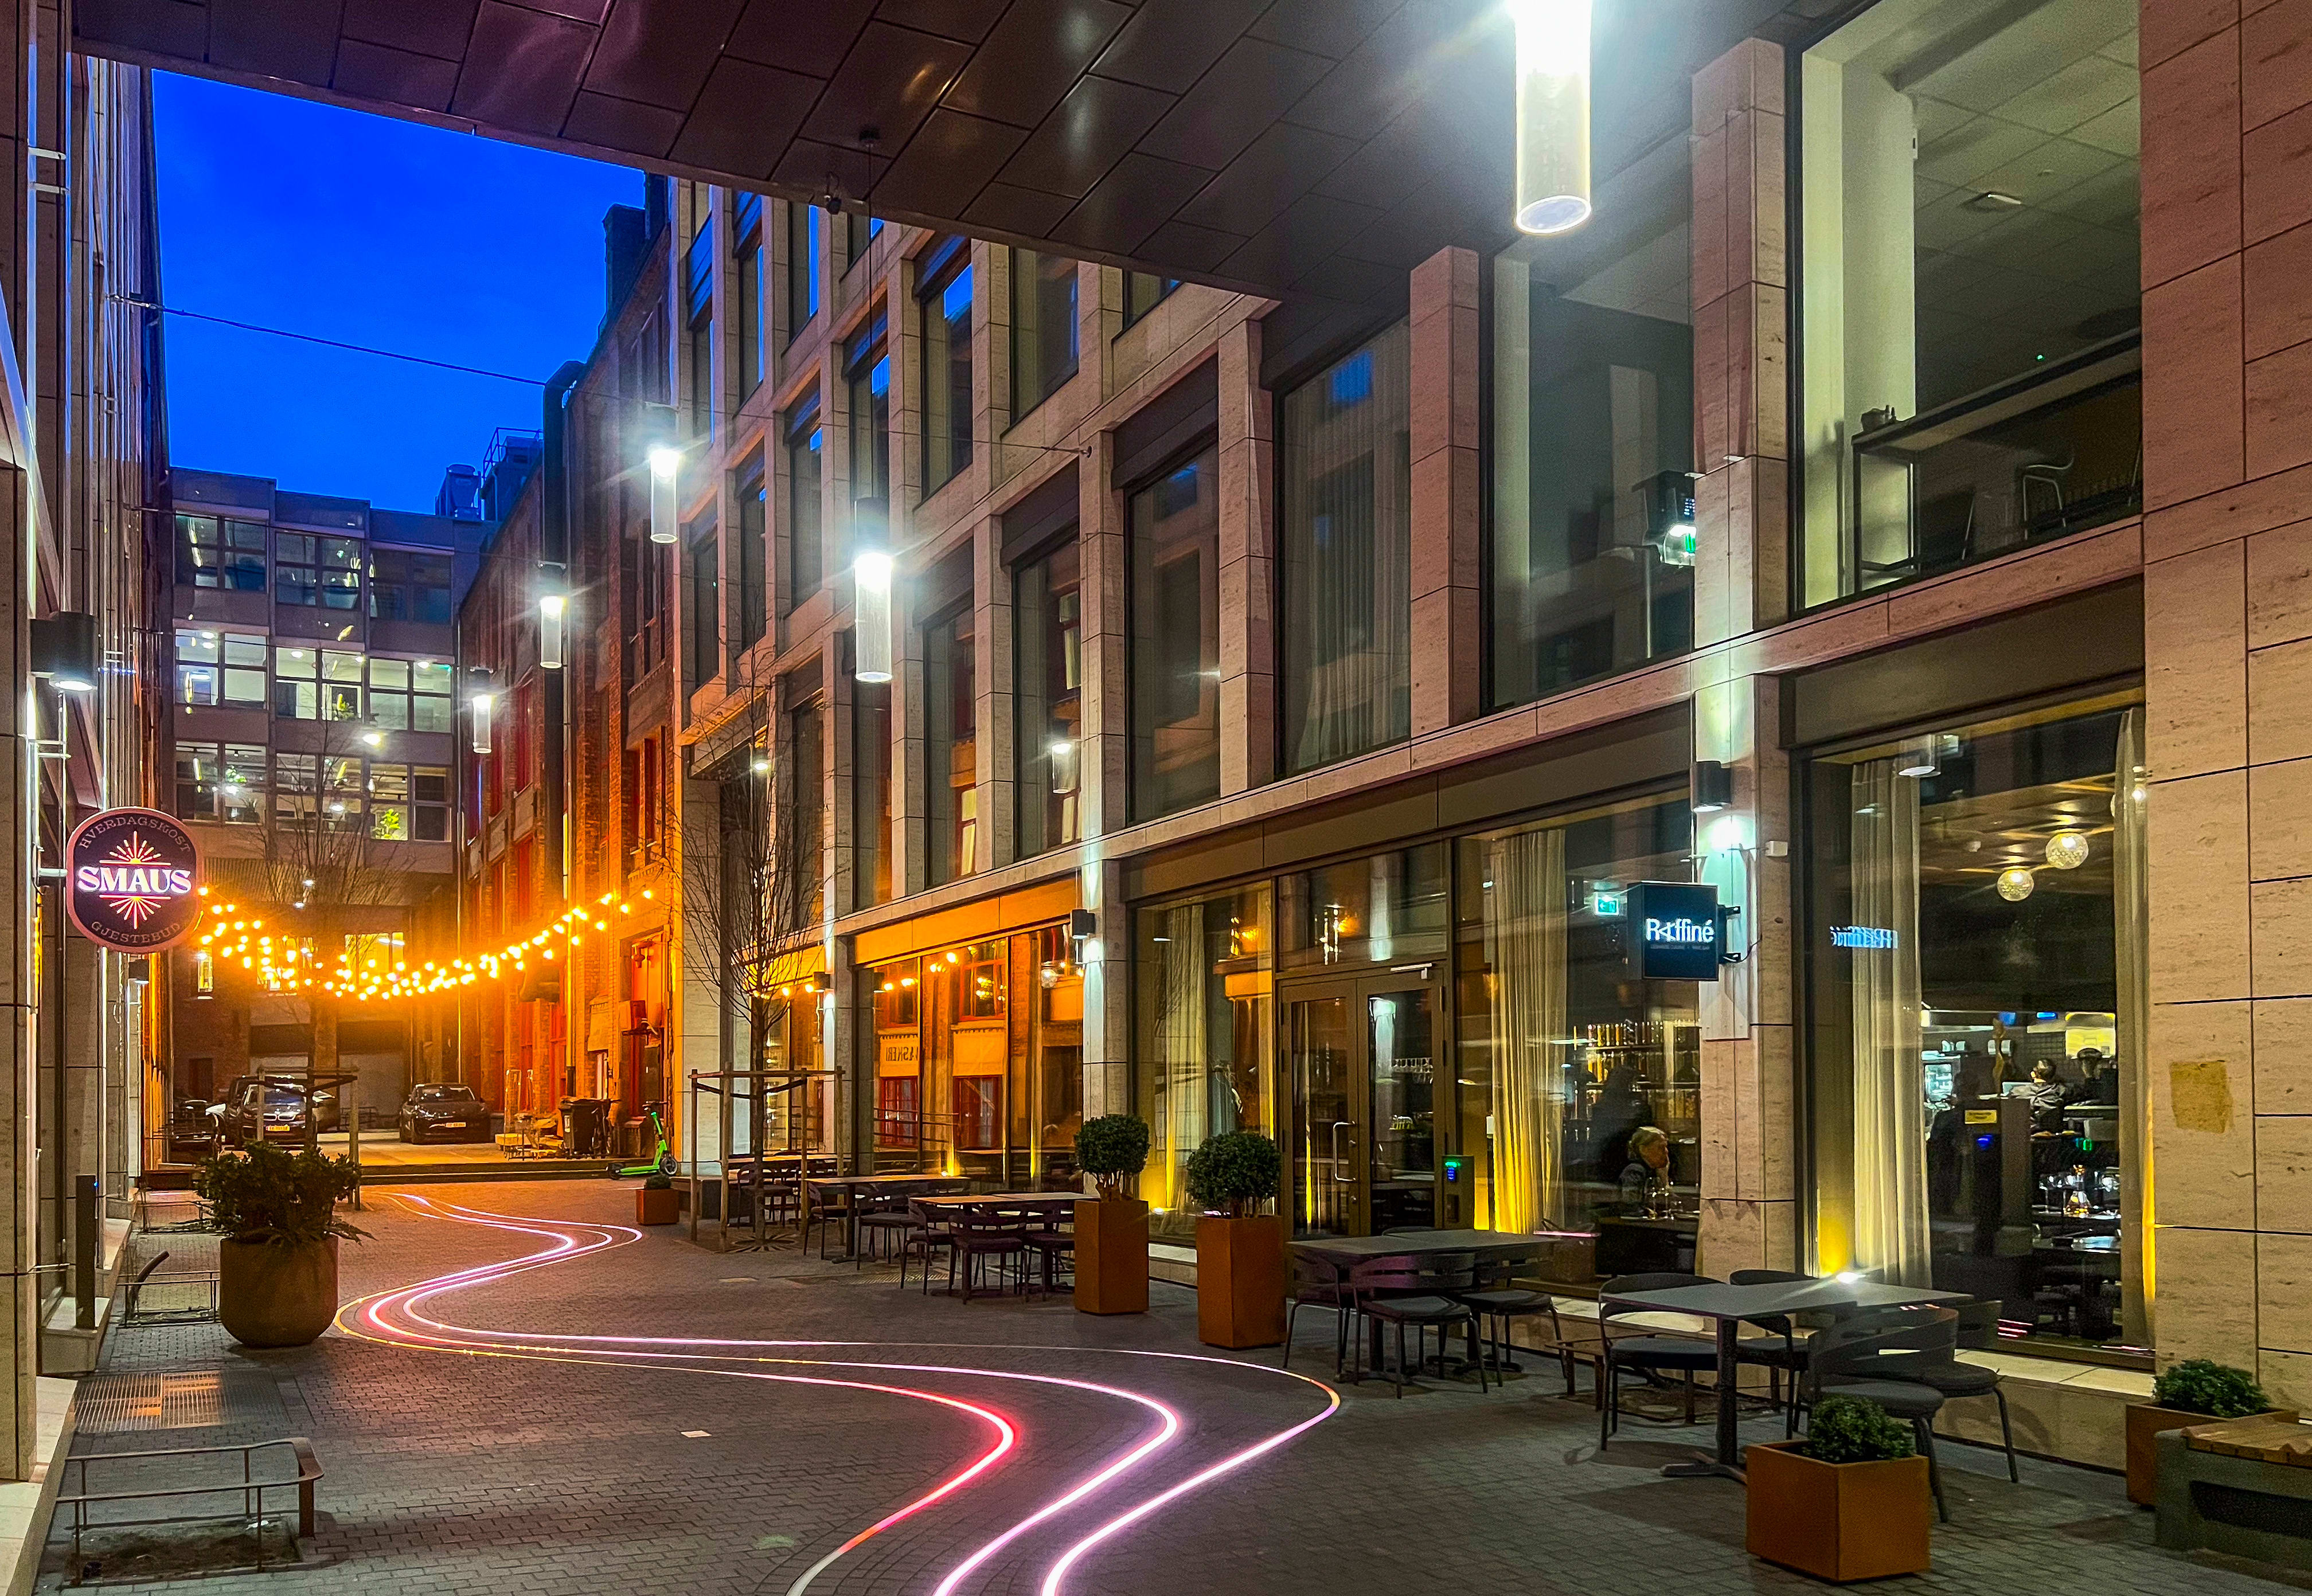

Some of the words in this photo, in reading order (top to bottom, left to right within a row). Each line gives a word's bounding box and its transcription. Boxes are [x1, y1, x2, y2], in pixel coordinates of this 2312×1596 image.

[79, 816, 190, 852] HVERDAGSKOST
[78, 866, 192, 894] SMAUS
[91, 921, 181, 943] GJESTEBUD
